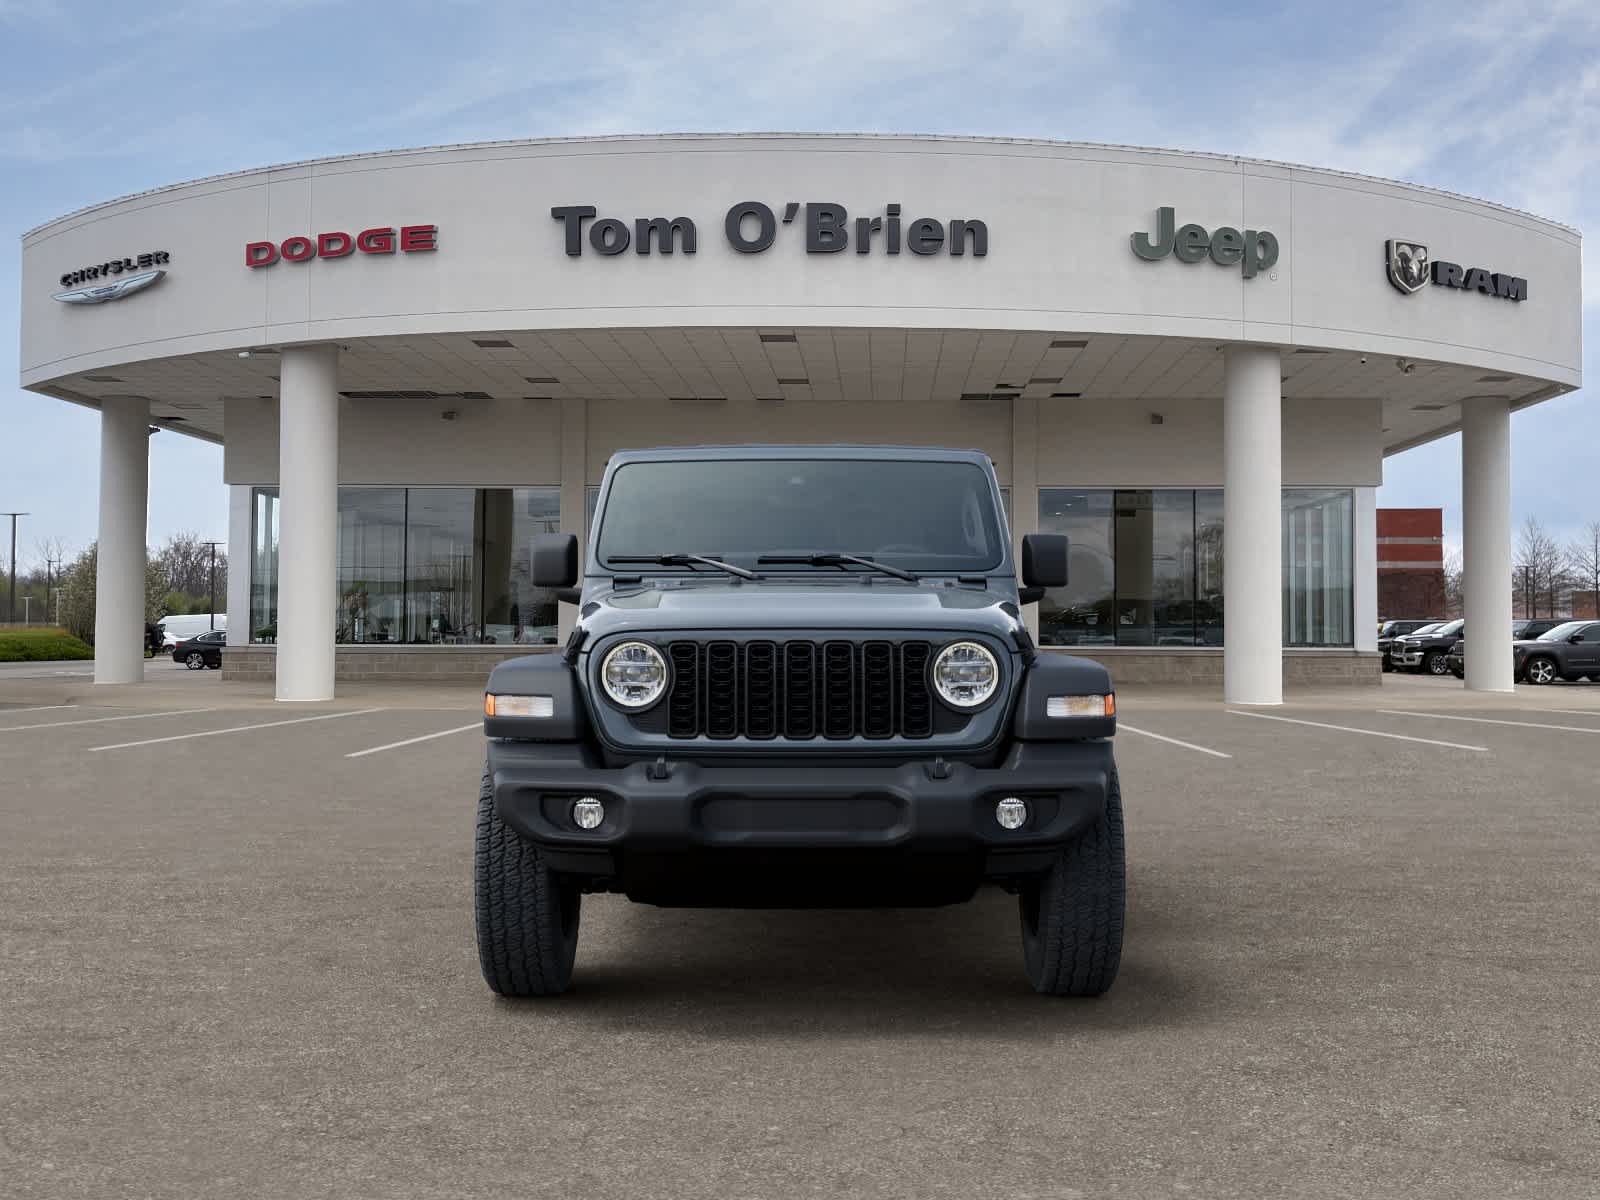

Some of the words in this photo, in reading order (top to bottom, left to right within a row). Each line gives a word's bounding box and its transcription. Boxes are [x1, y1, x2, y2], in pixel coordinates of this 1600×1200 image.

[245, 224, 439, 269] DODGE
[550, 205, 697, 257] Tom
[725, 201, 989, 257] O'Brien
[1130, 206, 1280, 280] Jeep
[60, 250, 171, 288] CHRYSLER
[1430, 260, 1528, 302] RAM
